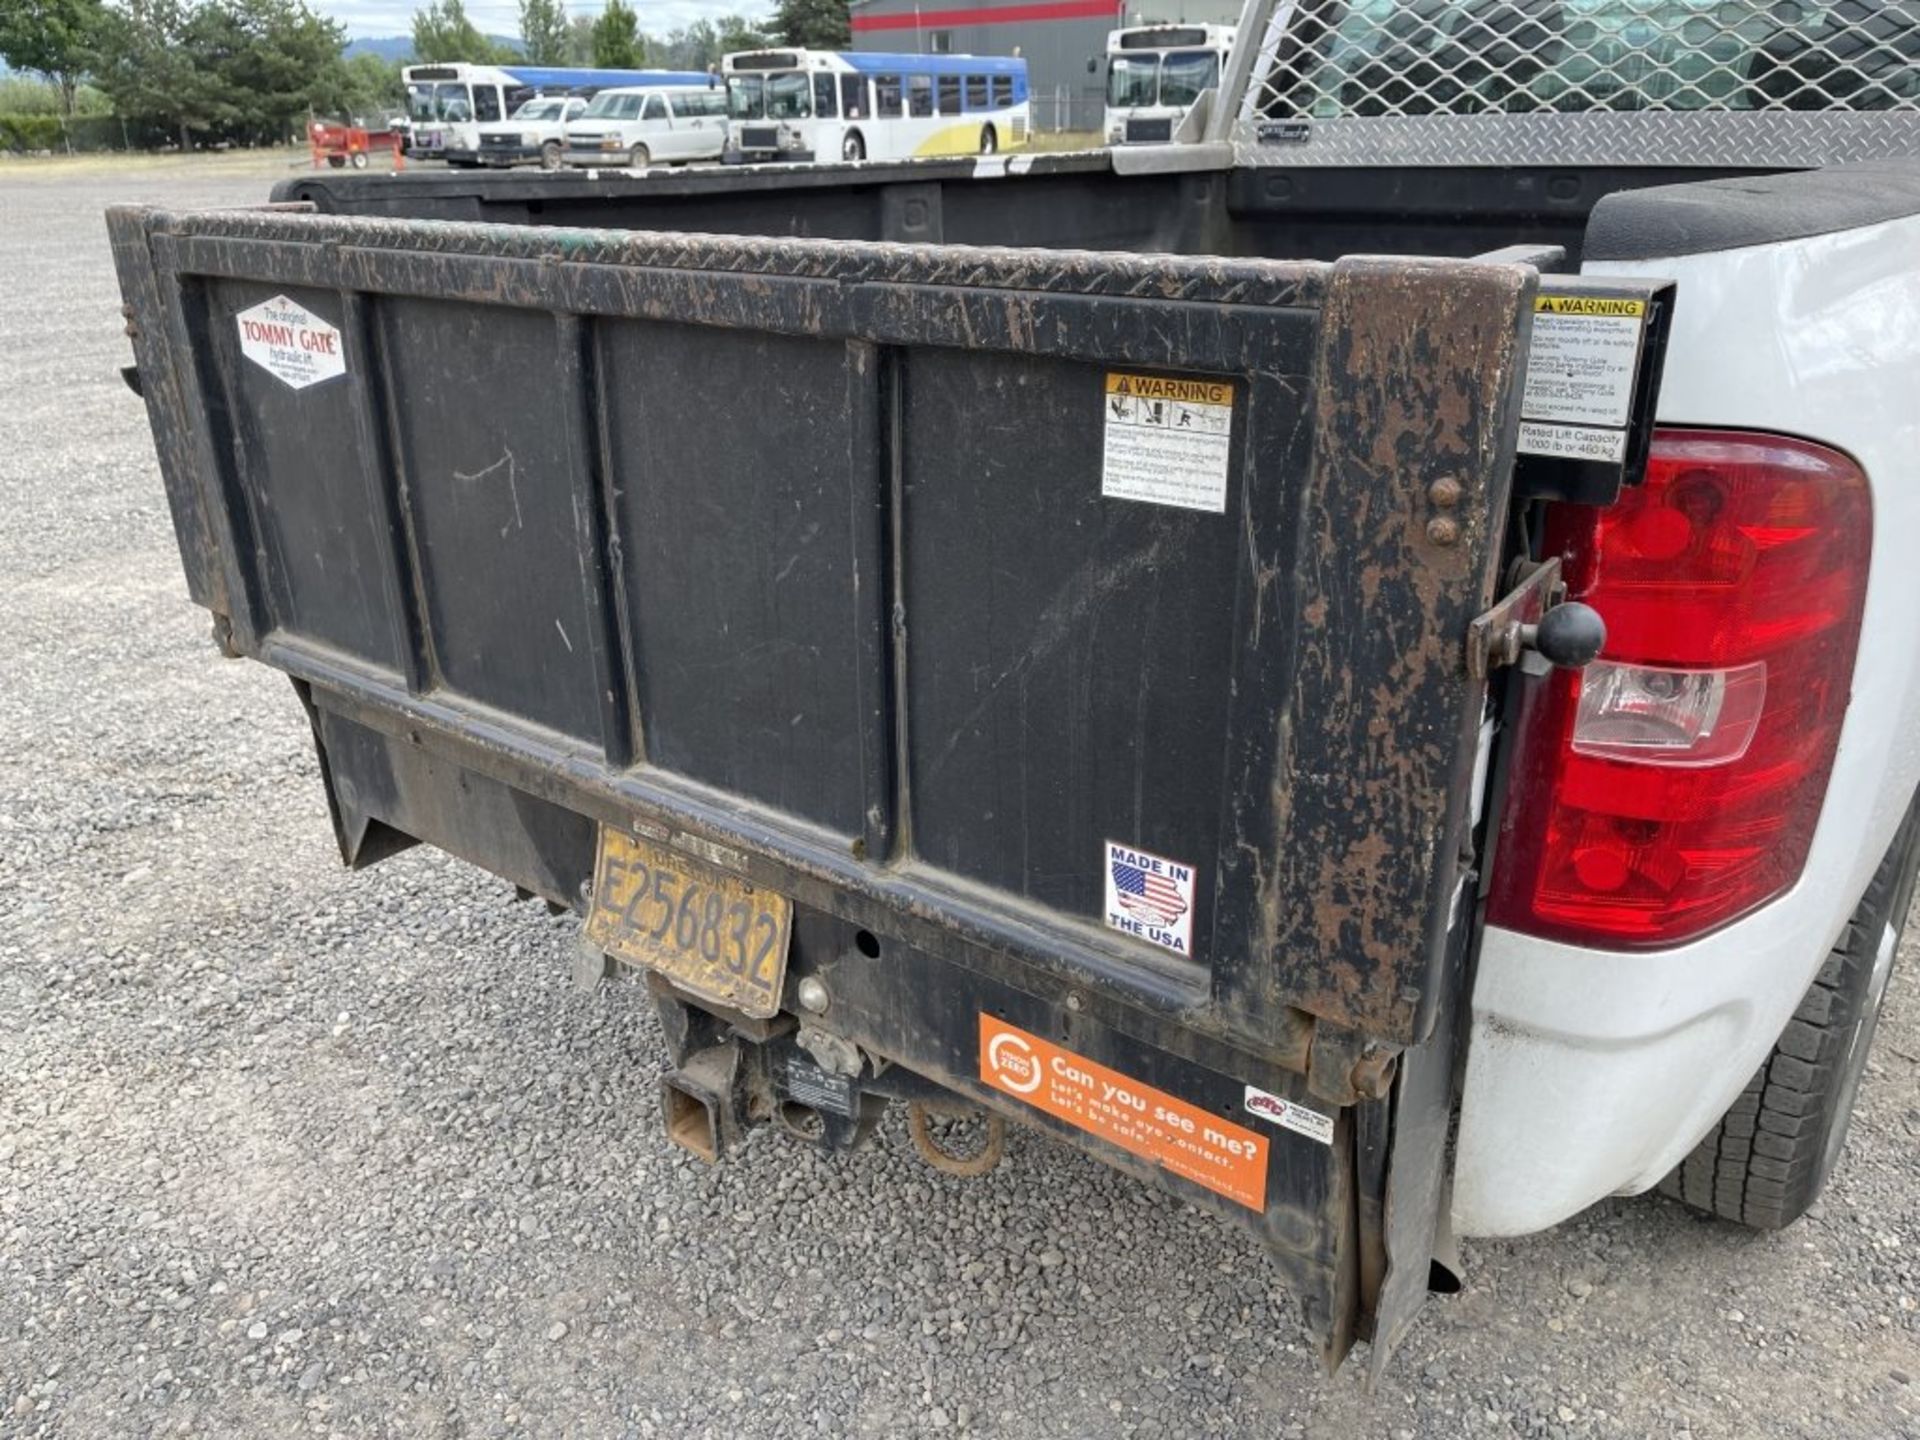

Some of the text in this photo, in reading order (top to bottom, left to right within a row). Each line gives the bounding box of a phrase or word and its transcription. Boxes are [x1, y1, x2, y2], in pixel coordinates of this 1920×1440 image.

[1558, 299, 1637, 315] WARNING
[242, 320, 294, 347] TOMMY
[1135, 378, 1223, 402] WARNING
[1522, 426, 1621, 446] Rated Lift Capacity
[1111, 846, 1189, 882] MADE IN
[601, 855, 778, 992] E256832
[1110, 912, 1185, 951] THE USA
[1000, 1058, 1030, 1078] ZERO
[1051, 1078, 1083, 1101] Let's
[1088, 1098, 1130, 1122] make
[1136, 1119, 1163, 1137] eye
[1051, 1056, 1095, 1090] Can
[1102, 1081, 1147, 1112] you
[1154, 1106, 1196, 1133] see
[1203, 1127, 1258, 1161] me?
[1051, 1091, 1150, 1145] Let's be safe.
